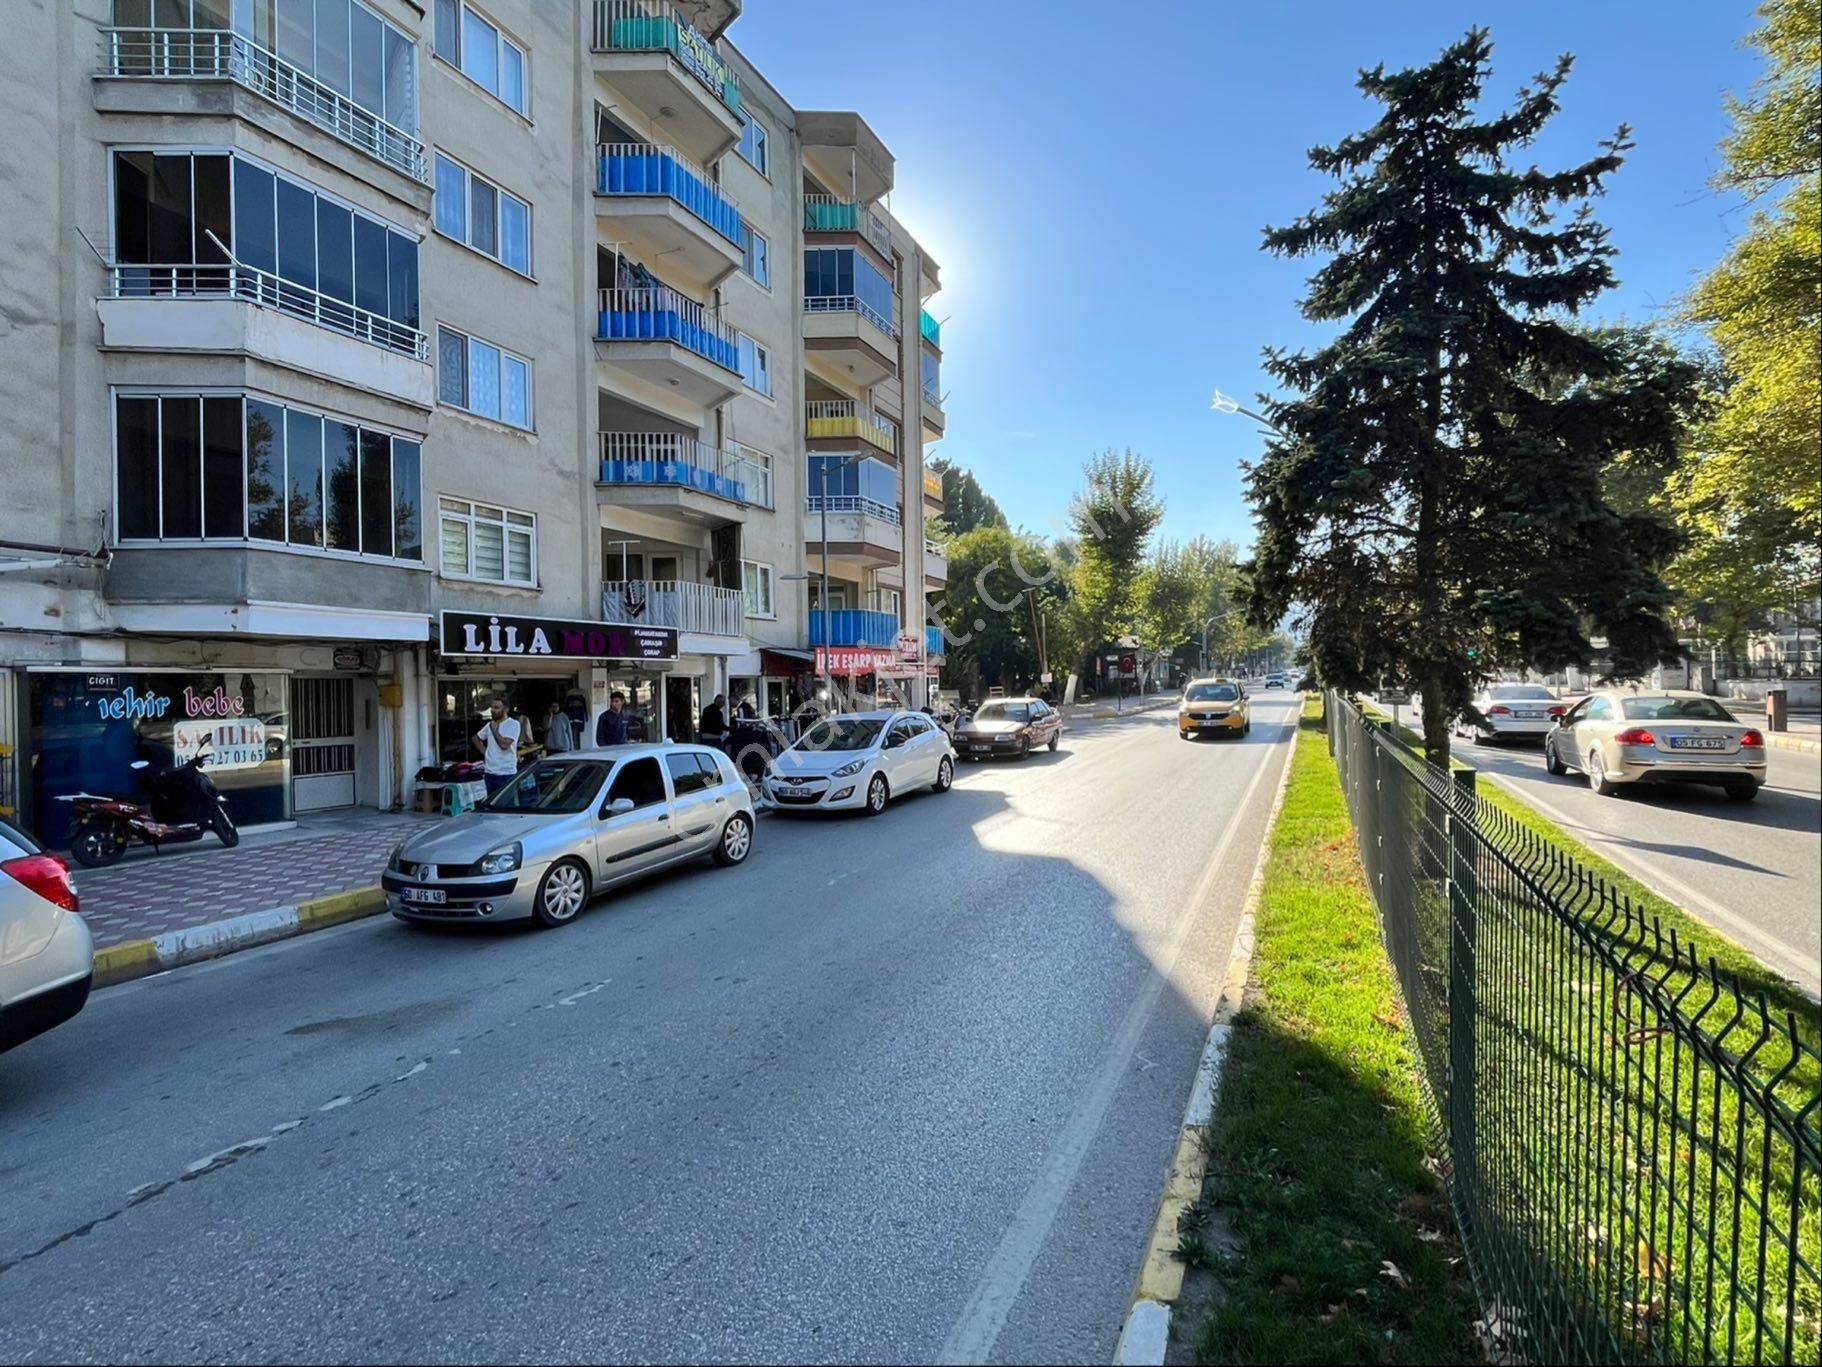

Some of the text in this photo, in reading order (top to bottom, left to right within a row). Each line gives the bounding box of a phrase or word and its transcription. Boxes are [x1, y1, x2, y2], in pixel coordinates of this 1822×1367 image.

[463, 617, 552, 654] LİLA
[842, 654, 871, 674] EŞARP
[183, 686, 245, 718] bebe
